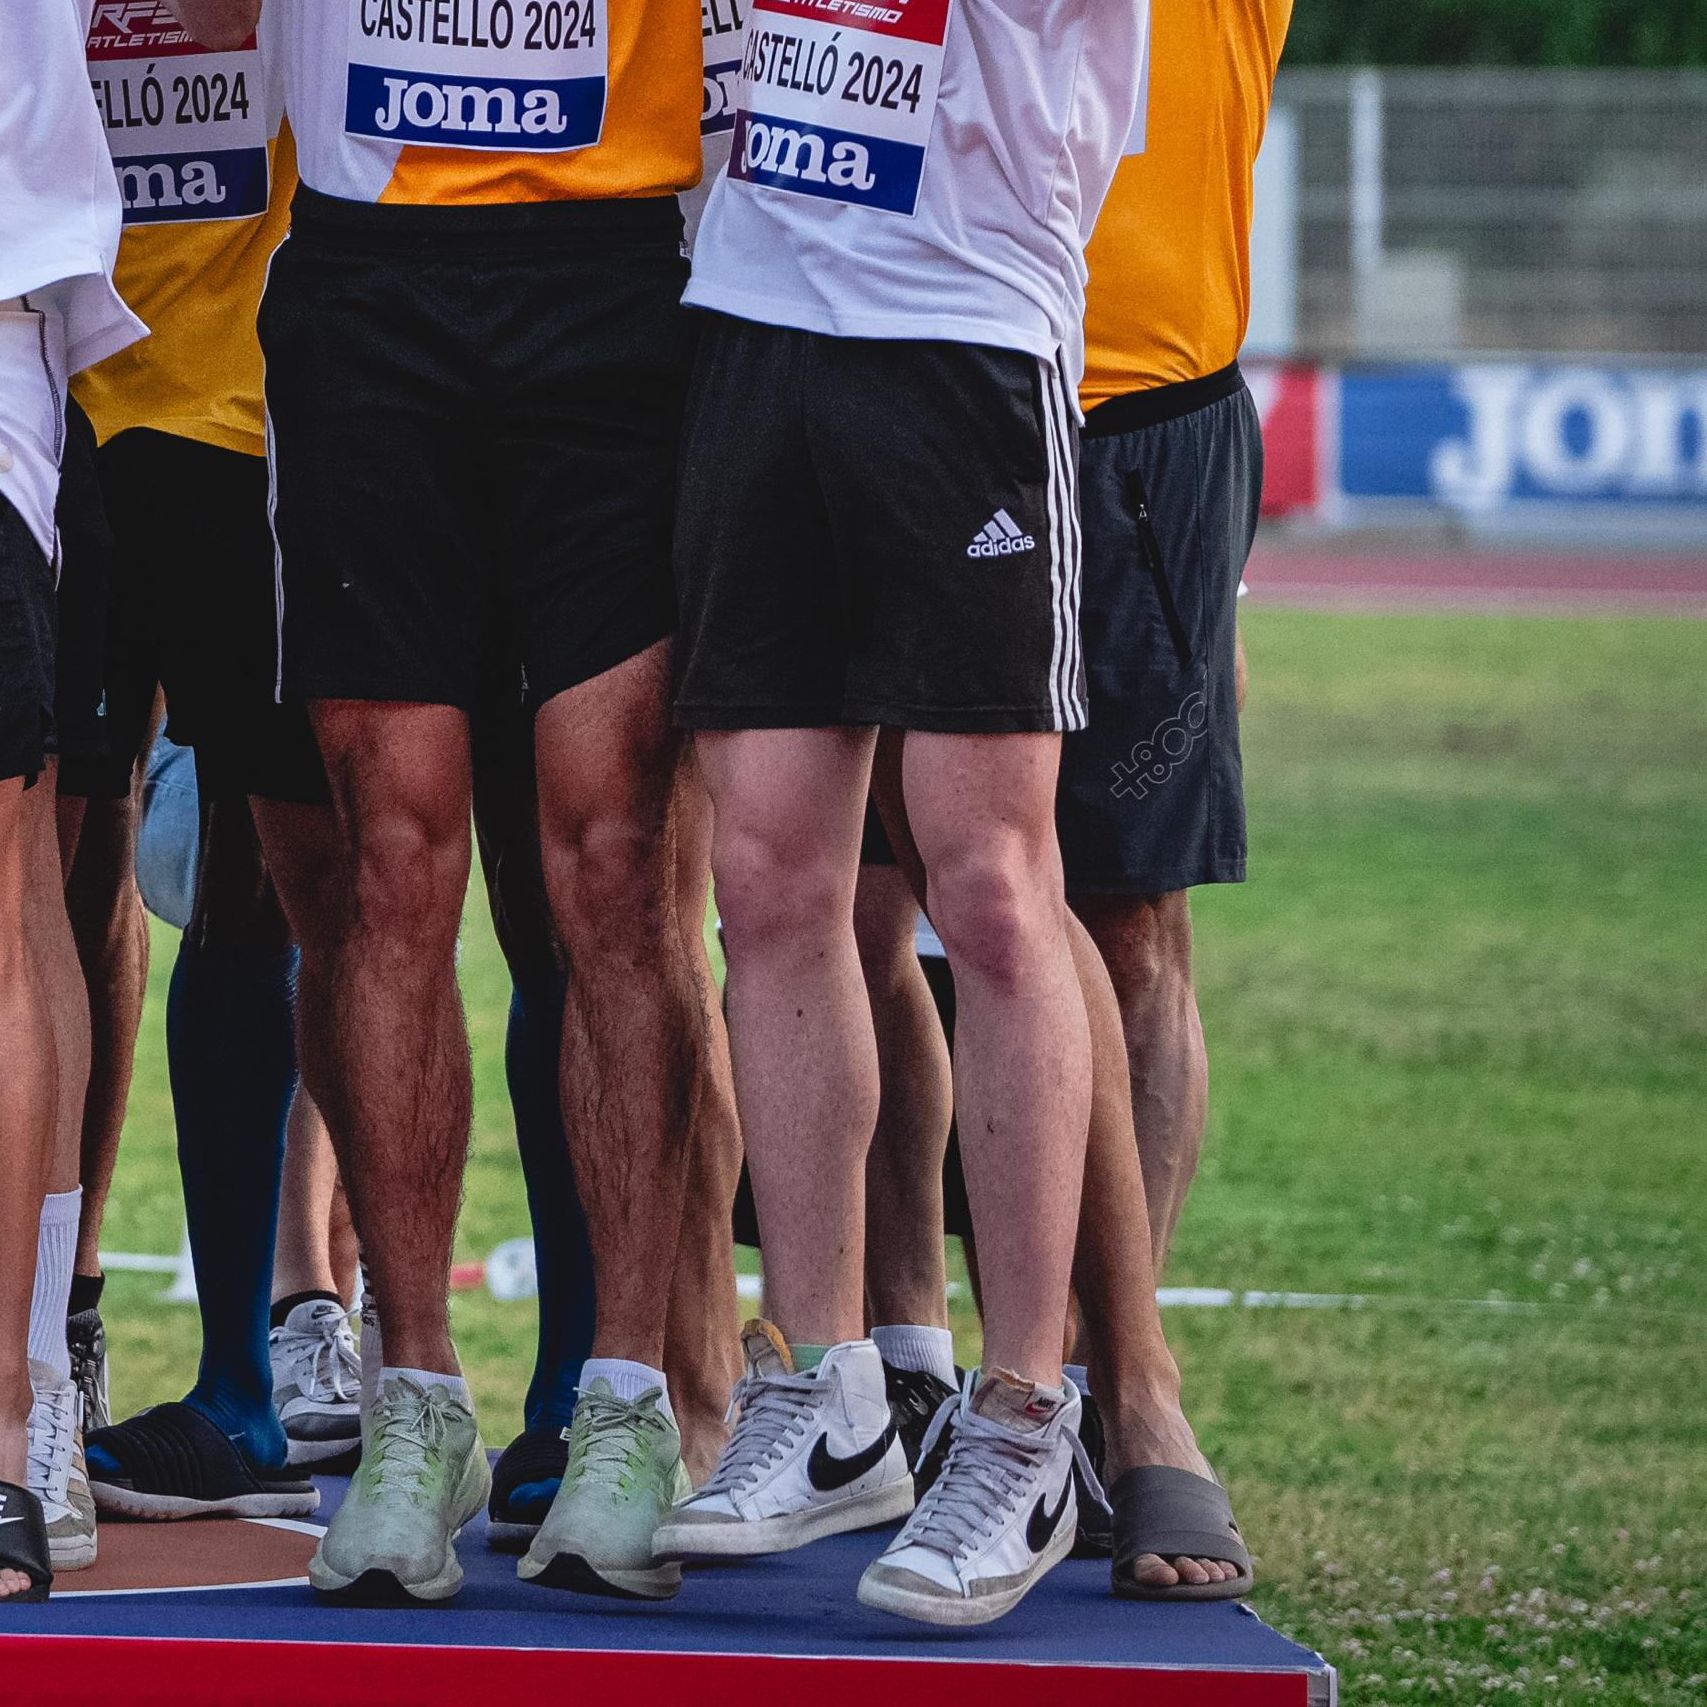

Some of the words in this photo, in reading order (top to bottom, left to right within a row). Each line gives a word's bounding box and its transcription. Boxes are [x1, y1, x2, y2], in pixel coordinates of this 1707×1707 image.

[93, 1, 182, 34] RFE
[95, 63, 164, 130] ELLÓ
[172, 71, 249, 125] 2024
[743, 31, 838, 96] CASTELLÓ
[843, 51, 923, 113] 2024
[375, 78, 567, 134] Joma
[113, 159, 226, 209] ma
[742, 119, 875, 191] oma
[1430, 364, 1707, 507] Jo
[966, 531, 1036, 559] adidas
